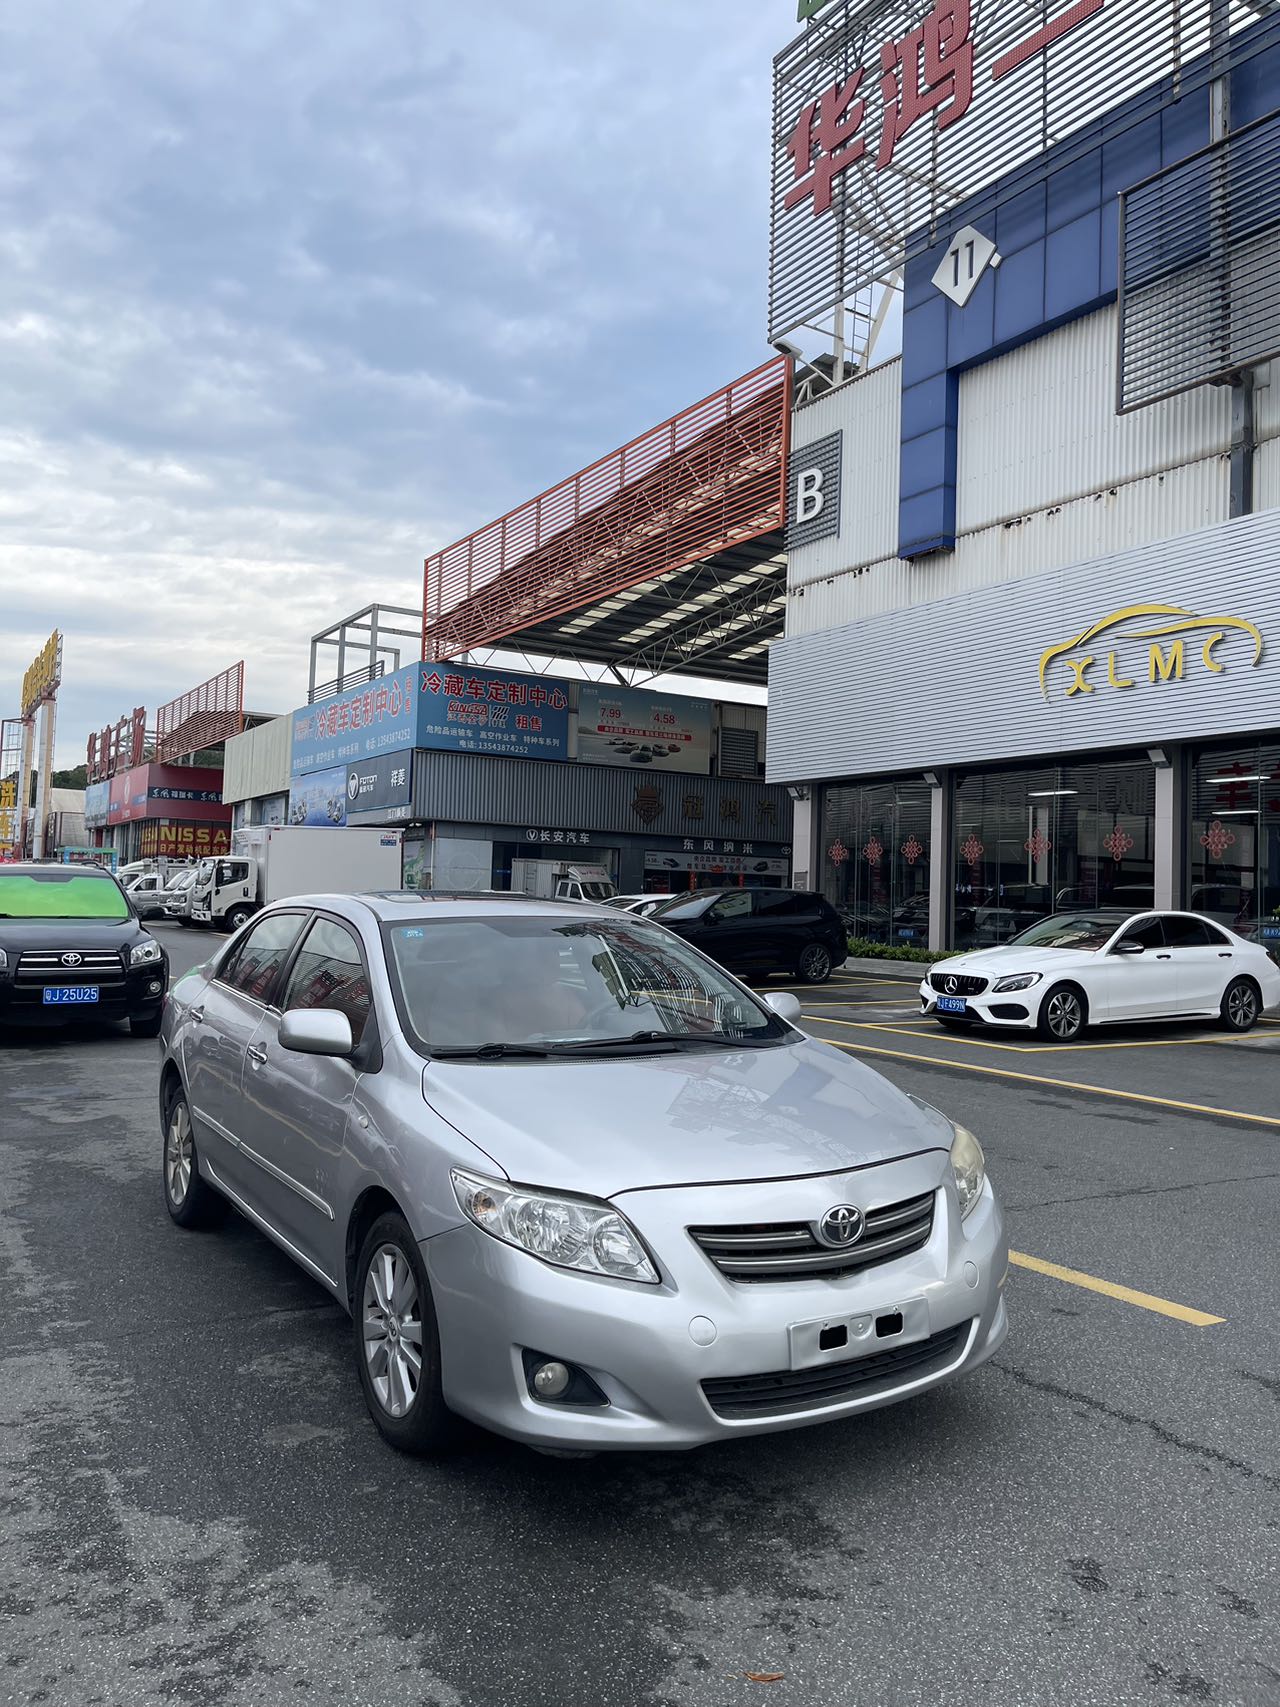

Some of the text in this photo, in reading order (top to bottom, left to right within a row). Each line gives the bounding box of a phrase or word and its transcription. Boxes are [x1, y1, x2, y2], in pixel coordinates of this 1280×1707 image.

[950, 240, 975, 288] 11
[796, 468, 824, 523] B
[1064, 631, 1226, 697] XLMC
[421, 671, 568, 710] 冷藏车定制中心
[315, 679, 403, 740] 冷藏车定制中心
[516, 714, 543, 731] 租售
[653, 713, 676, 725] 4.58
[479, 731, 517, 742] 高空作业车
[523, 736, 560, 747] 特种车系列
[540, 830, 591, 845] 长安汽车
[683, 839, 753, 854] 东风纳米
